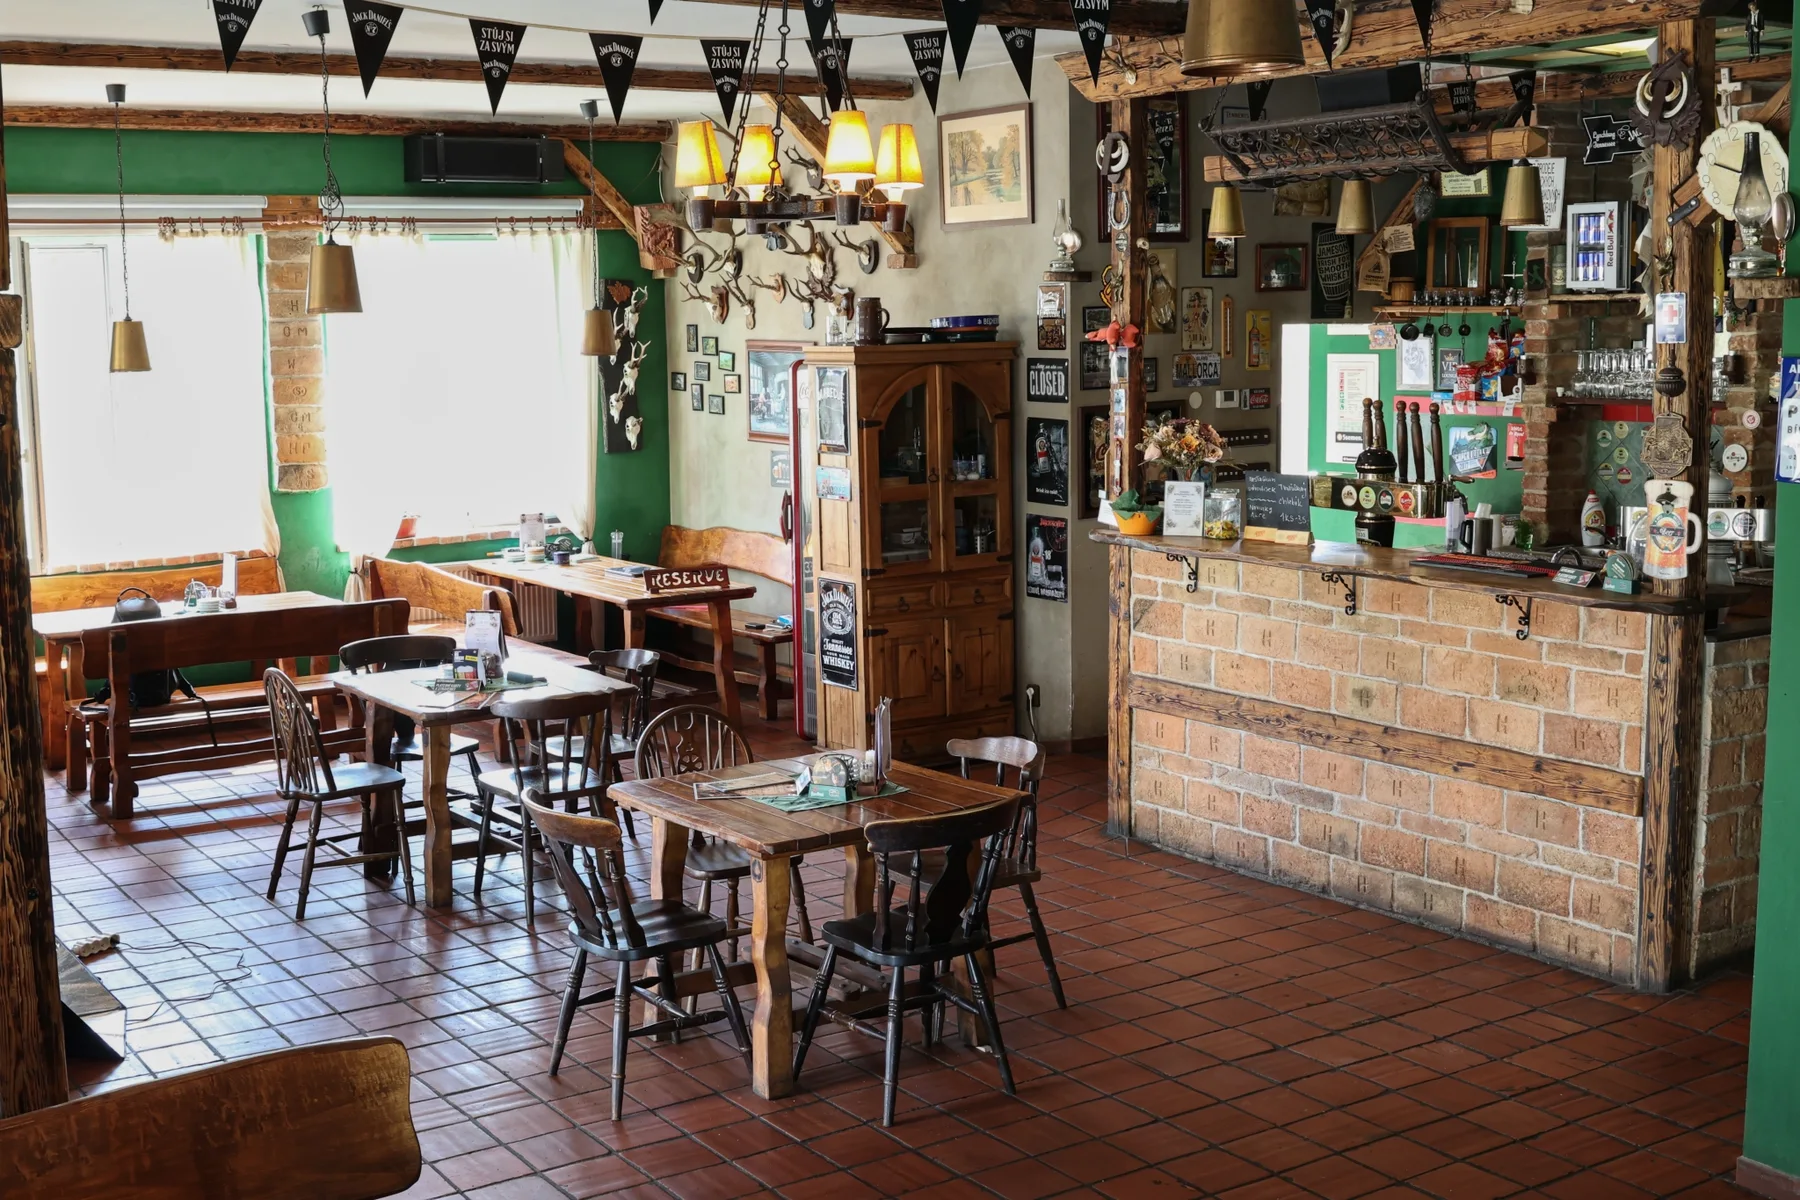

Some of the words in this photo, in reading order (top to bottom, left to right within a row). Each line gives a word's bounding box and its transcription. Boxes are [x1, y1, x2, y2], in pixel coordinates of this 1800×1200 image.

[353, 12, 368, 23] JACK
[368, 9, 393, 30] DANIEL'S
[481, 26, 504, 41] STŮJ
[505, 30, 514, 42] SI
[480, 40, 490, 51] ZA
[491, 41, 515, 55] SVÝM
[914, 36, 932, 49] STŮJ
[932, 37, 940, 48] SI
[599, 44, 612, 57] JACK
[612, 41, 634, 60] DANIEL'S
[711, 44, 732, 57] STŮJ
[732, 46, 740, 58] SI
[914, 50, 923, 60] ZA
[923, 47, 942, 60] SVÝM
[711, 58, 721, 69] ZA
[721, 56, 742, 69] SVÝM
[1725, 127, 1740, 141] 12
[1712, 136, 1723, 150] 11
[1761, 141, 1771, 155] 2
[1773, 162, 1782, 176] 3
[1702, 174, 1711, 188] 9
[1712, 191, 1721, 204] 8
[1317, 242, 1348, 257] JAMESON
[1606, 235, 1614, 250] Bull
[1606, 251, 1614, 267] Red
[1319, 270, 1350, 282] WHISKEY
[1176, 362, 1219, 379] MALLORCA
[1030, 370, 1065, 396] CLOSED
[1659, 526, 1675, 537] Beer
[652, 569, 725, 588] RESERVE
[821, 590, 833, 608] JACK
[833, 587, 853, 612] DANIEL'S
[823, 637, 853, 655] Tennessee
[822, 654, 854, 670] WHISKEY
